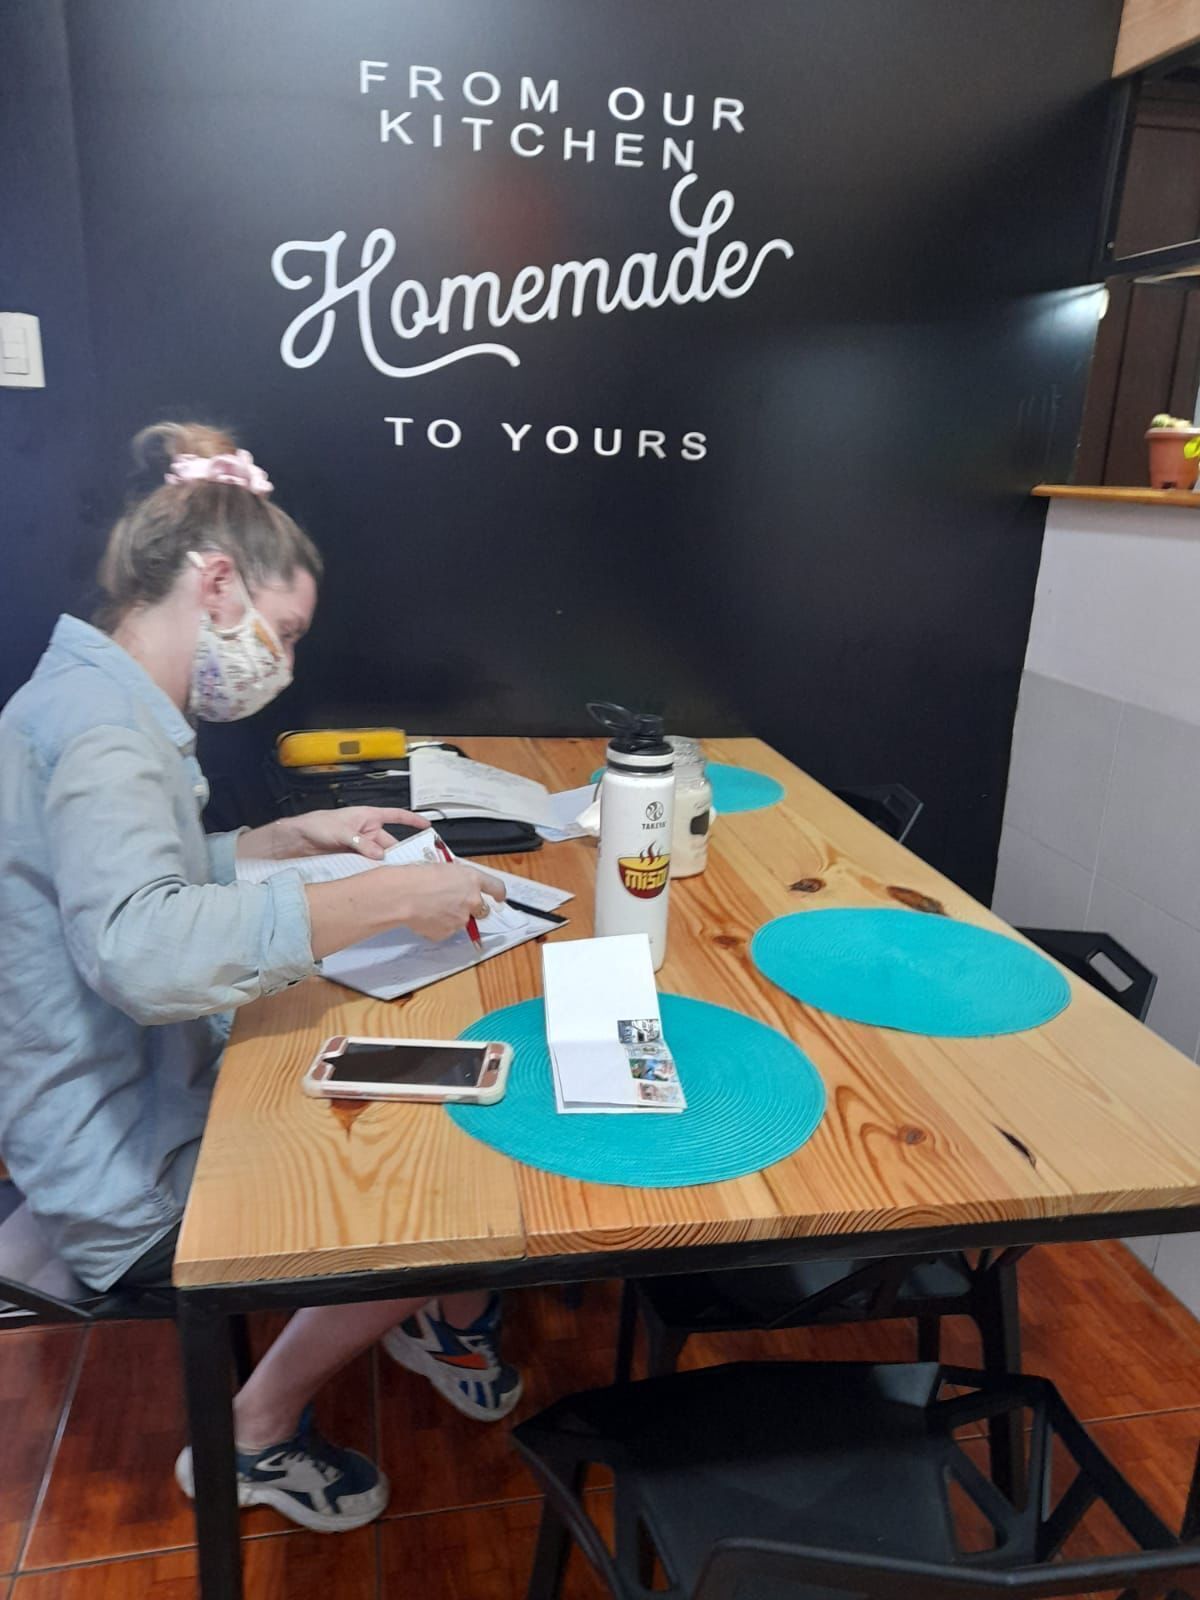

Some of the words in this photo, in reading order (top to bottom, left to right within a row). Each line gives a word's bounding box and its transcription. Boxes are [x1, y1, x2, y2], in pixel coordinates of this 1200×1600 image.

[359, 60, 559, 114] FROM
[607, 86, 745, 133] OUR
[380, 109, 695, 172] KITCHEN
[271, 173, 795, 378] Homemade
[384, 416, 462, 449] TO
[501, 422, 707, 460] YOURS
